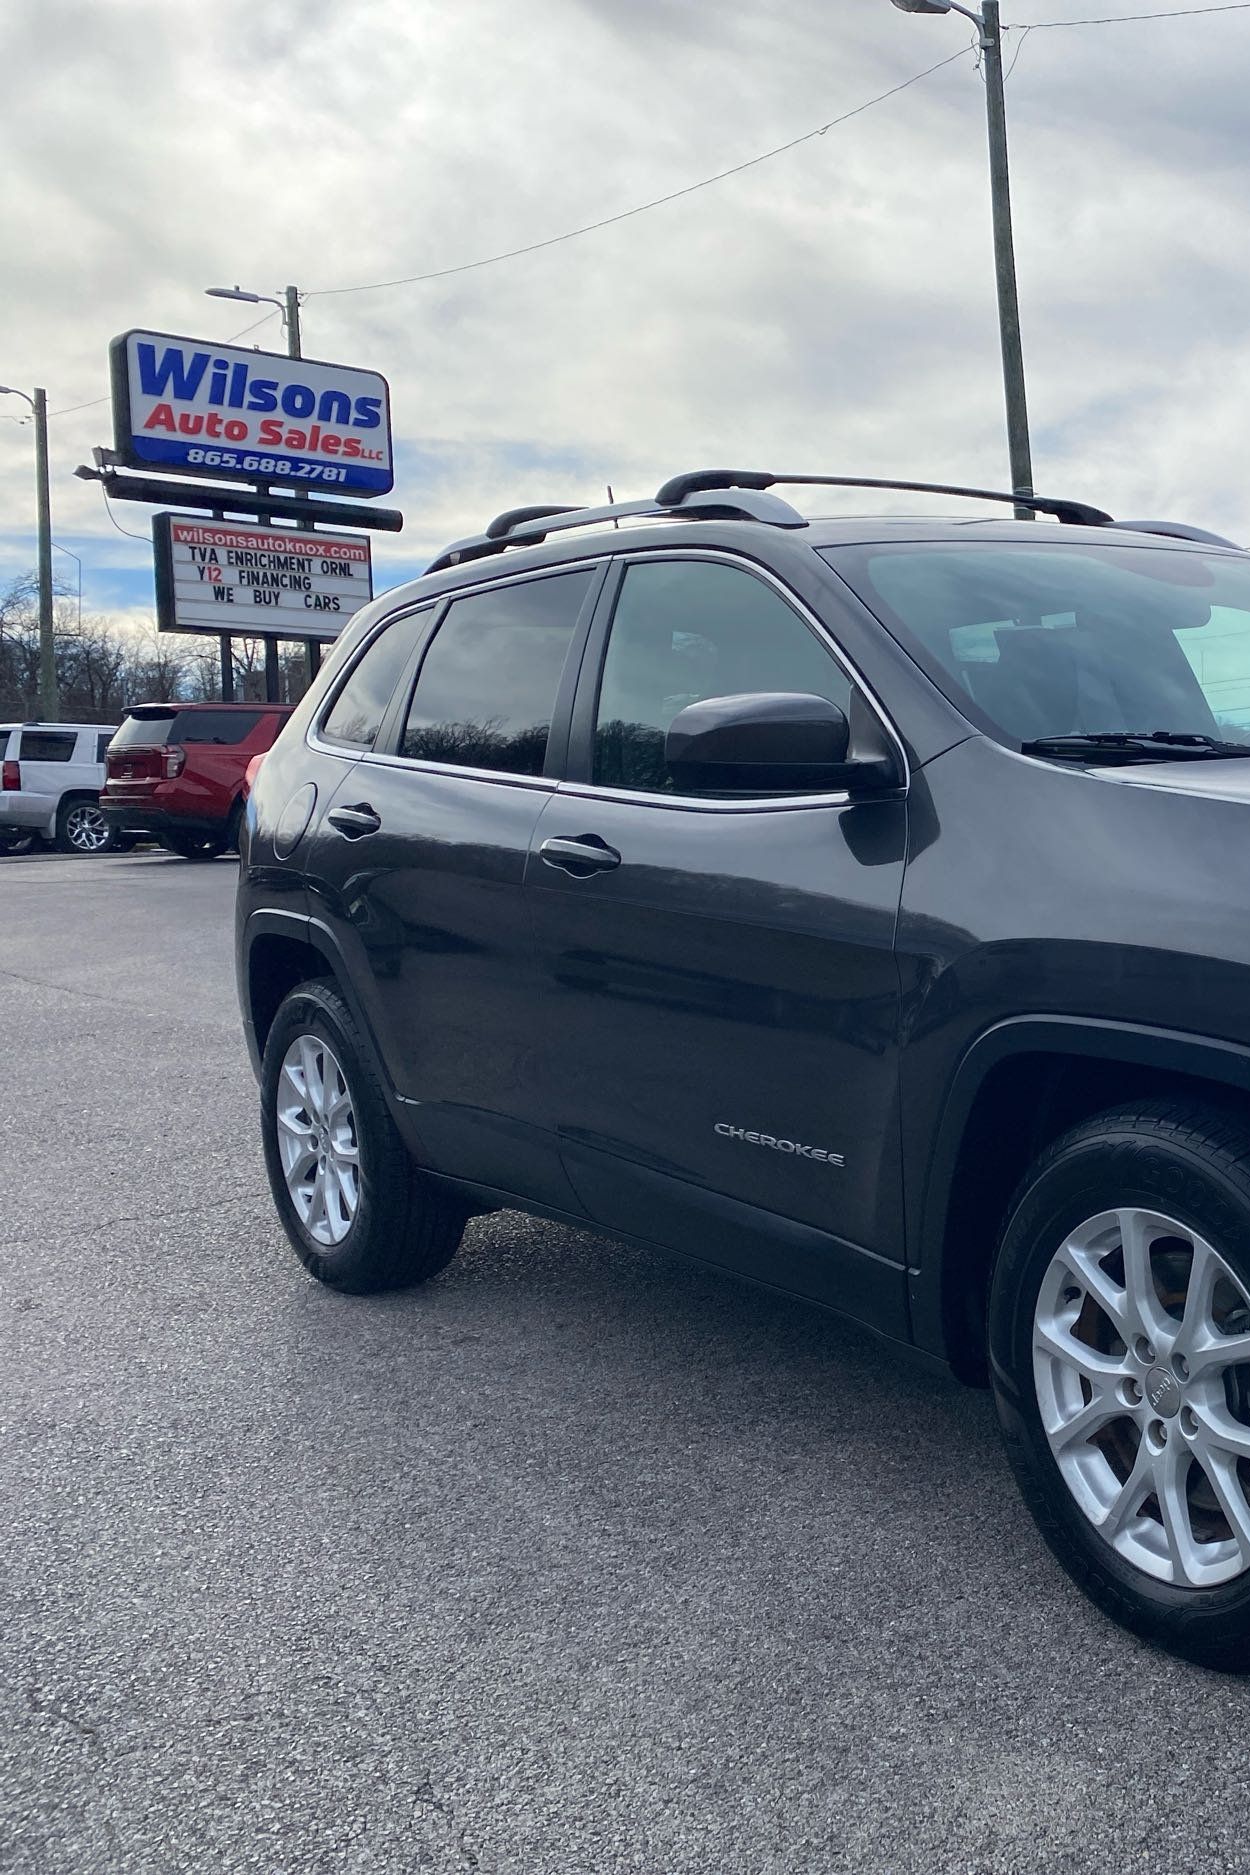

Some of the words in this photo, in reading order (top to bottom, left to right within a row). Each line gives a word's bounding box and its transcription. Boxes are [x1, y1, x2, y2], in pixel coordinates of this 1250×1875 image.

[136, 342, 382, 429] Wilsons
[143, 403, 248, 441] Auto
[257, 419, 362, 457] Sales
[360, 448, 383, 461] LLC
[187, 449, 347, 482] 865.688.2781
[177, 528, 365, 561] wilsonsautoknox.com
[188, 546, 219, 563] TVA
[227, 550, 313, 573] ENRICHMENT
[321, 560, 353, 577] ORNL
[197, 566, 222, 582] Y12
[239, 570, 311, 590] FINANCING
[213, 585, 234, 603] WE
[253, 589, 280, 606] BUY
[304, 594, 340, 611] CARS
[714, 1123, 846, 1167] CHEROKEE
[1151, 1377, 1171, 1406] Jeep
